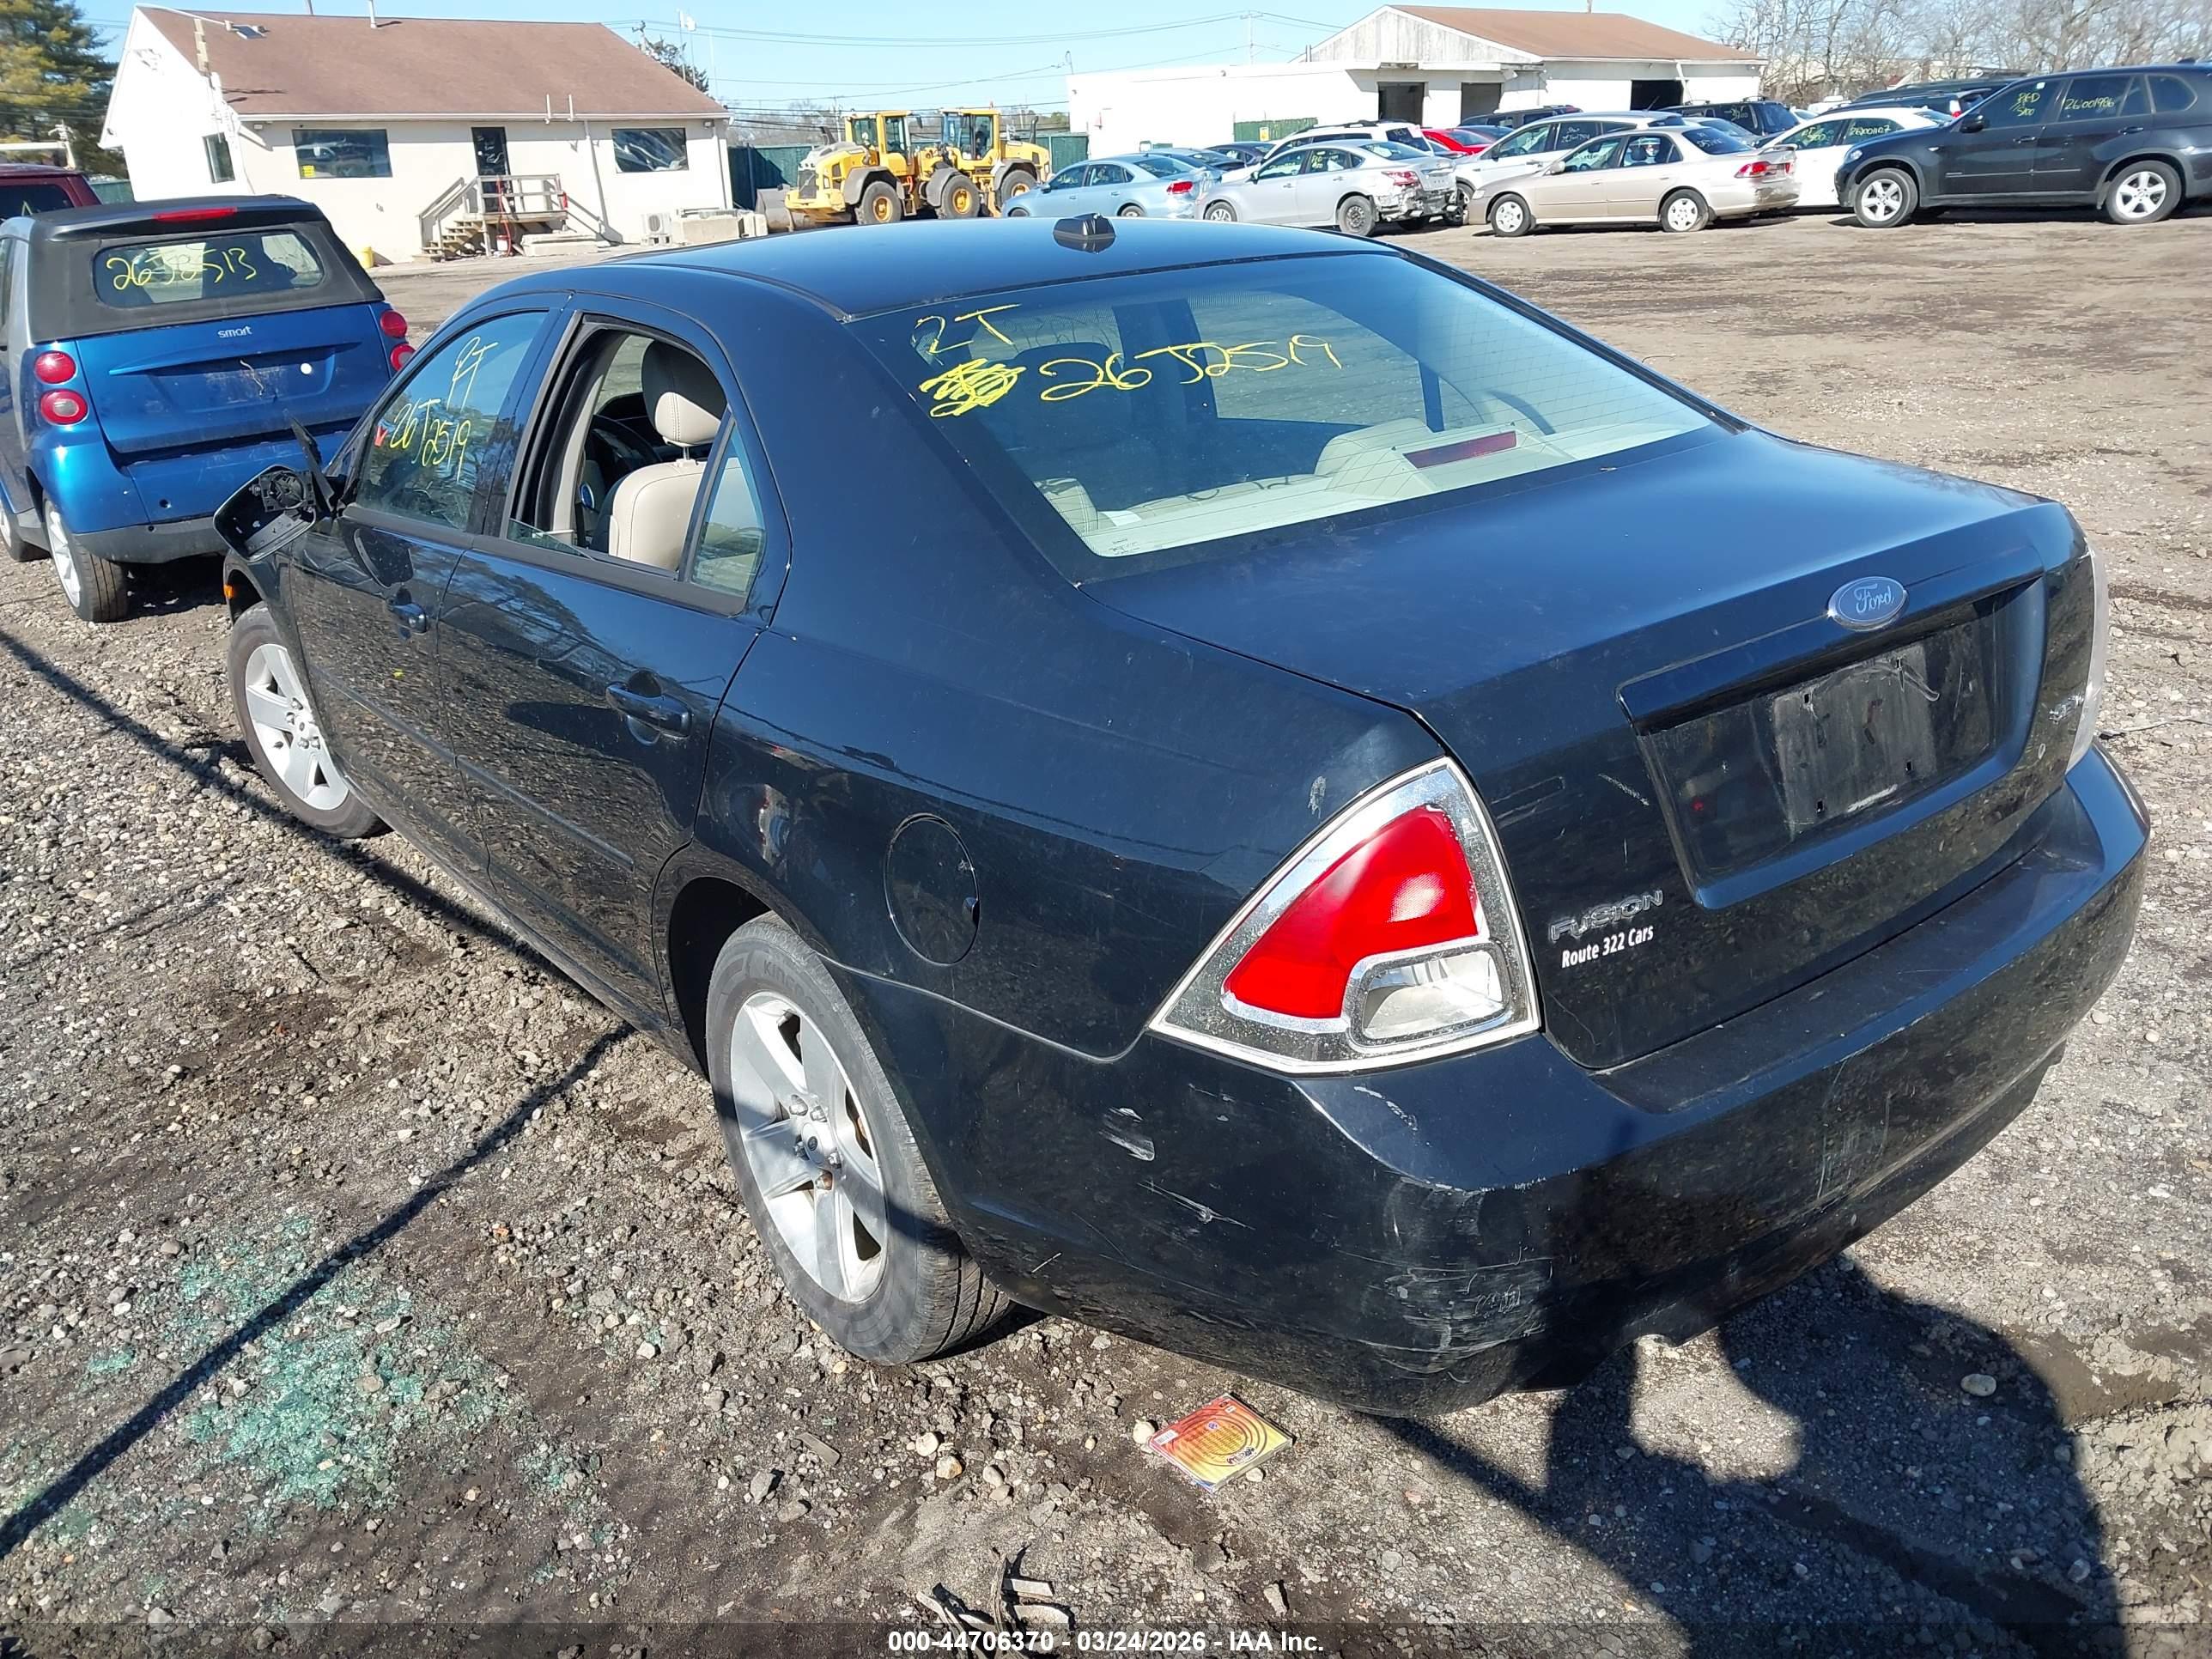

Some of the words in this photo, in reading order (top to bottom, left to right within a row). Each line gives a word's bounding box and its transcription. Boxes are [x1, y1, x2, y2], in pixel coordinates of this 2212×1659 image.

[217, 325, 253, 338] smart
[1854, 583, 1895, 614] Ford
[1550, 890, 1664, 942] FUSION
[1561, 945, 1600, 969] Route
[1602, 932, 1626, 957] 322
[1628, 925, 1654, 947] Cars
